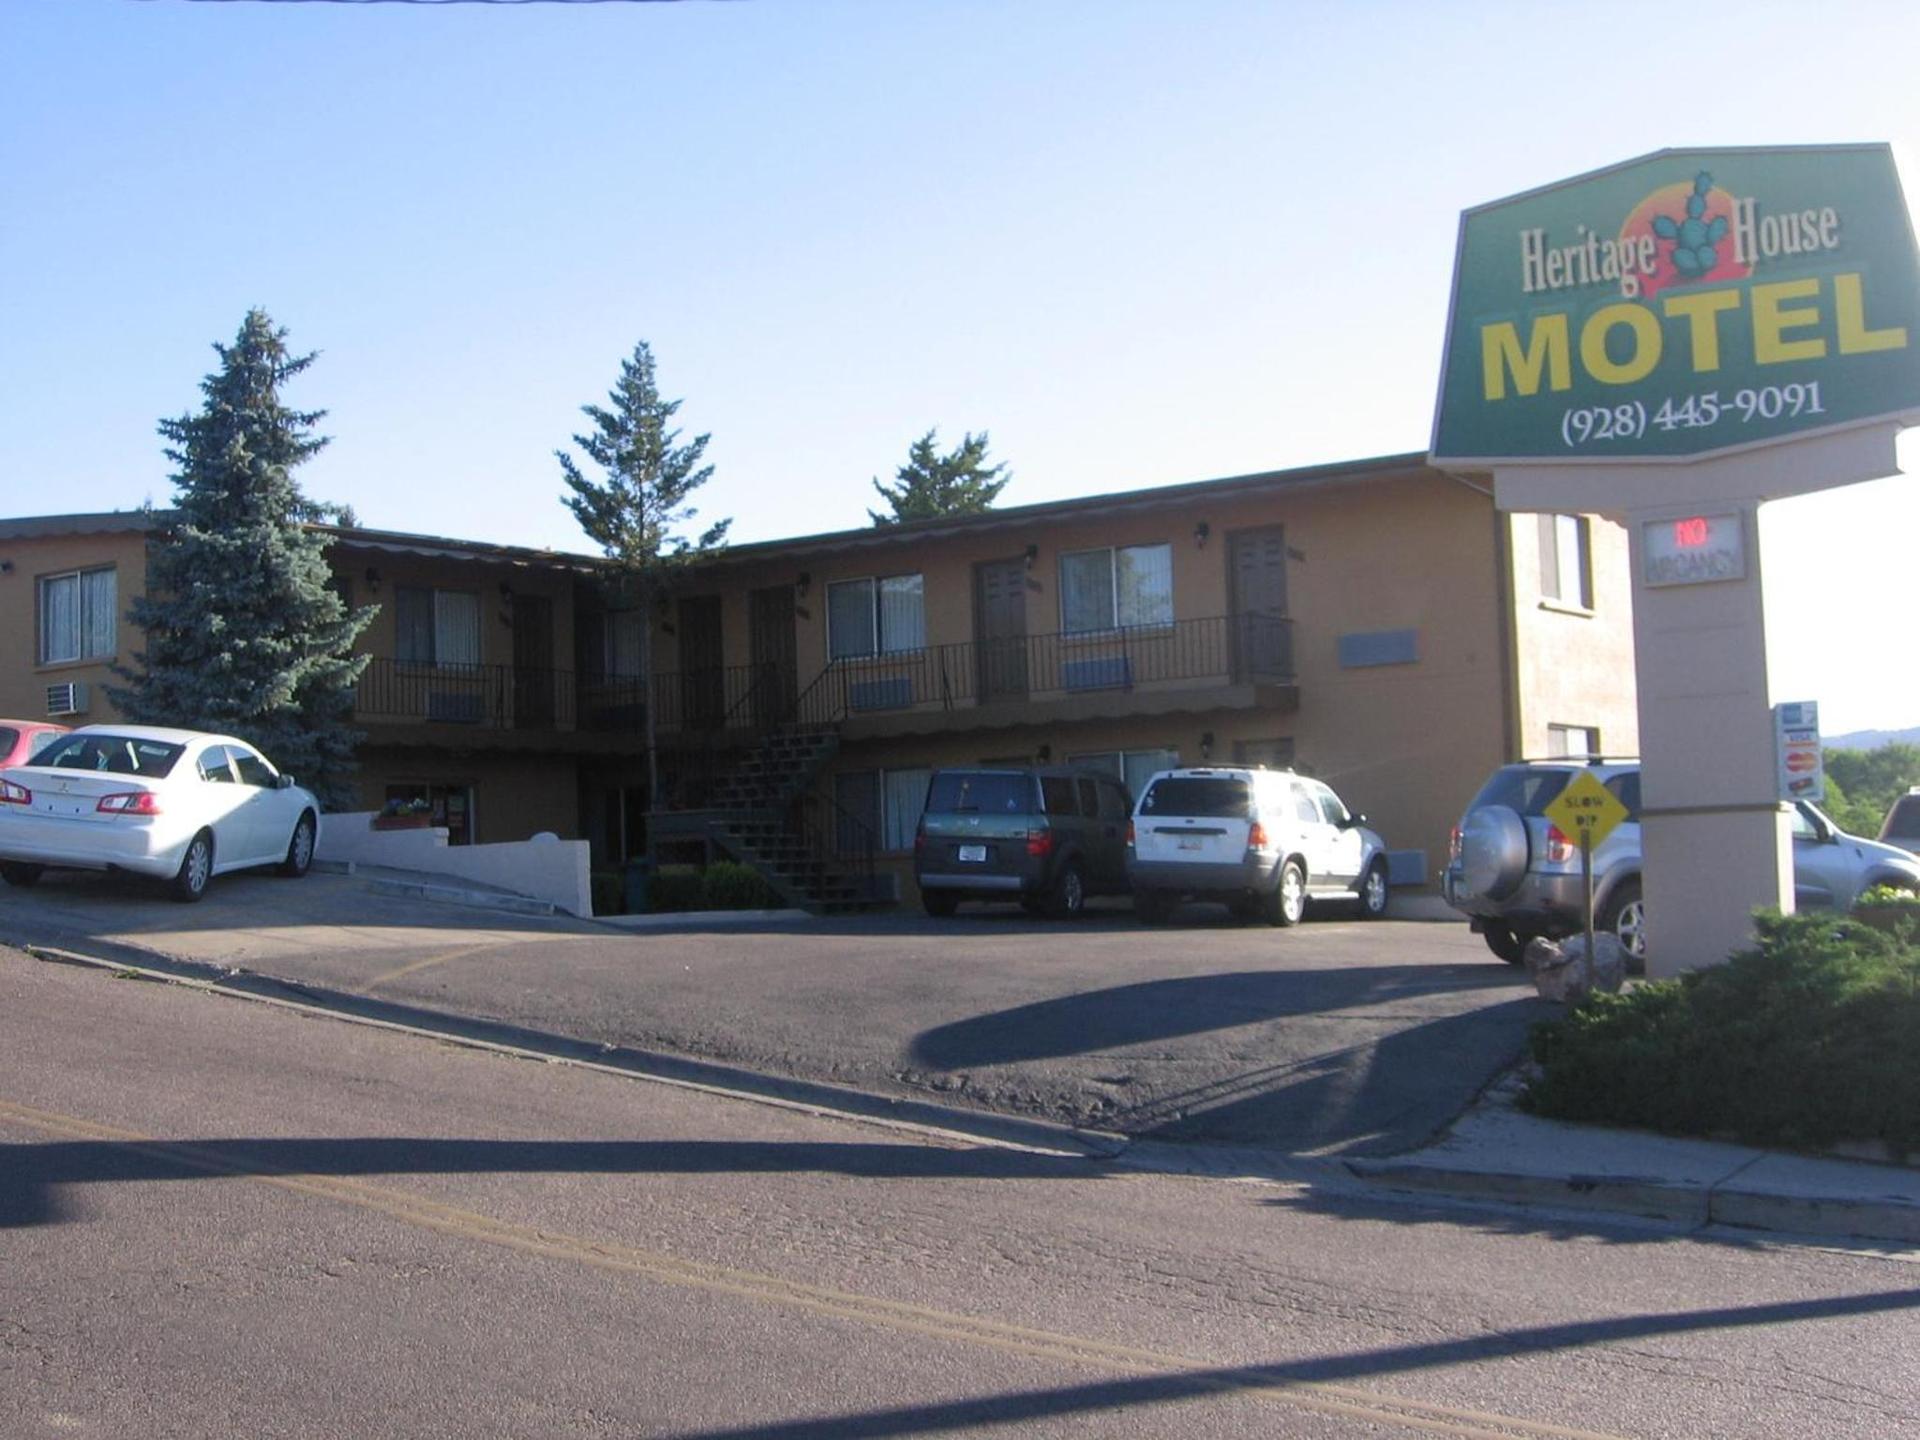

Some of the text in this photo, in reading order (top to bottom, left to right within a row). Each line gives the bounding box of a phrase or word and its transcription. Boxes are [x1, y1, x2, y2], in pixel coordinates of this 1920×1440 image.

[1521, 197, 1840, 299] Heritage House
[1481, 272, 1908, 401] MOTEL
[1561, 381, 1826, 447] (928) 445-9091
[1674, 517, 1709, 547] NO
[1564, 795, 1604, 809] SLOW
[1576, 815, 1598, 827] DIP
